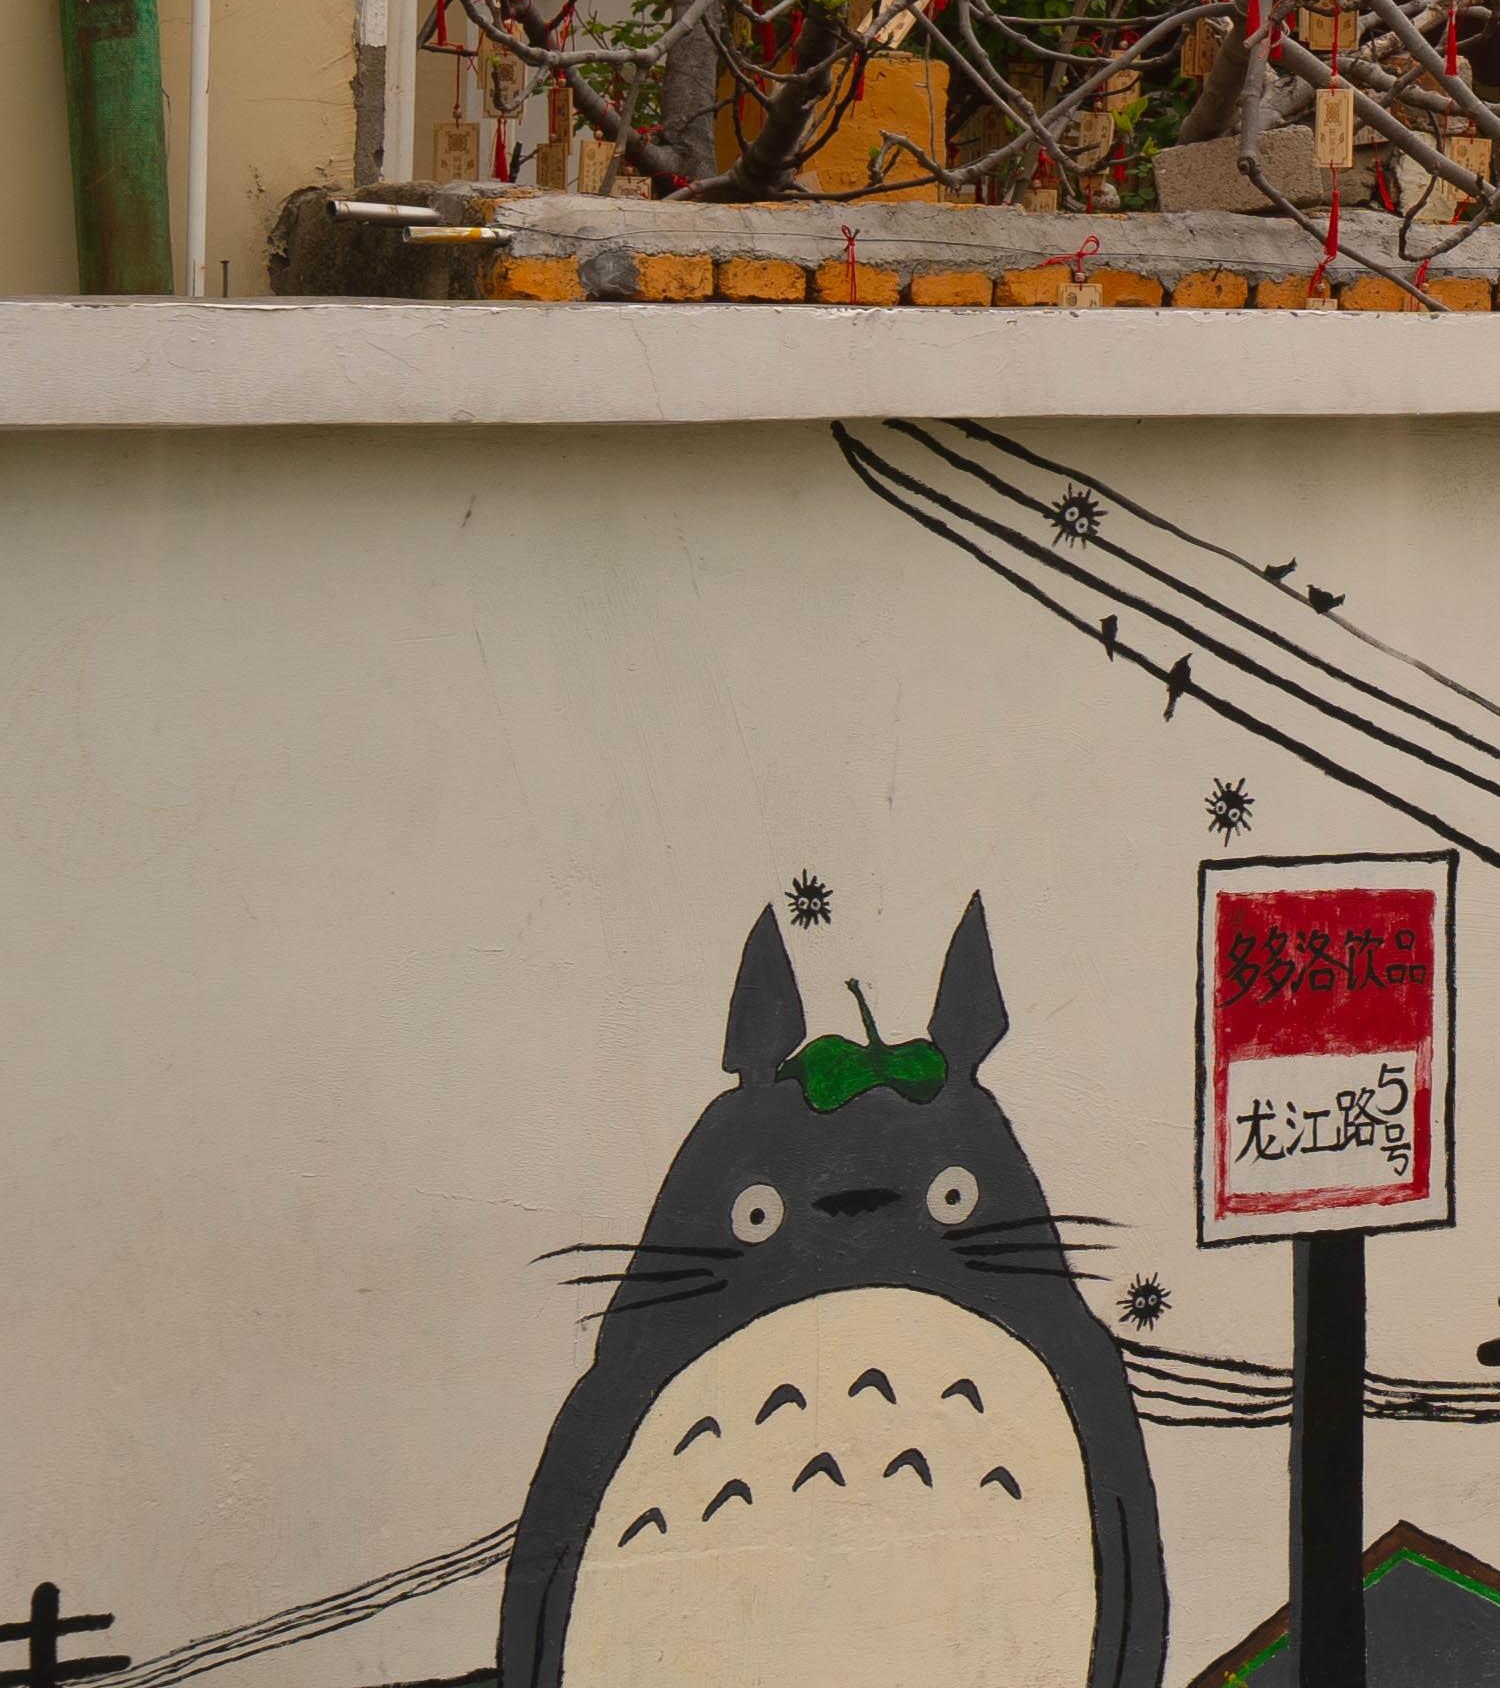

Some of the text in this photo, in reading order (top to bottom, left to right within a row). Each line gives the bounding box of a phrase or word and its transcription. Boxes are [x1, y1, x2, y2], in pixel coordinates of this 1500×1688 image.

[1219, 925, 1427, 1008] 多多洛饮品
